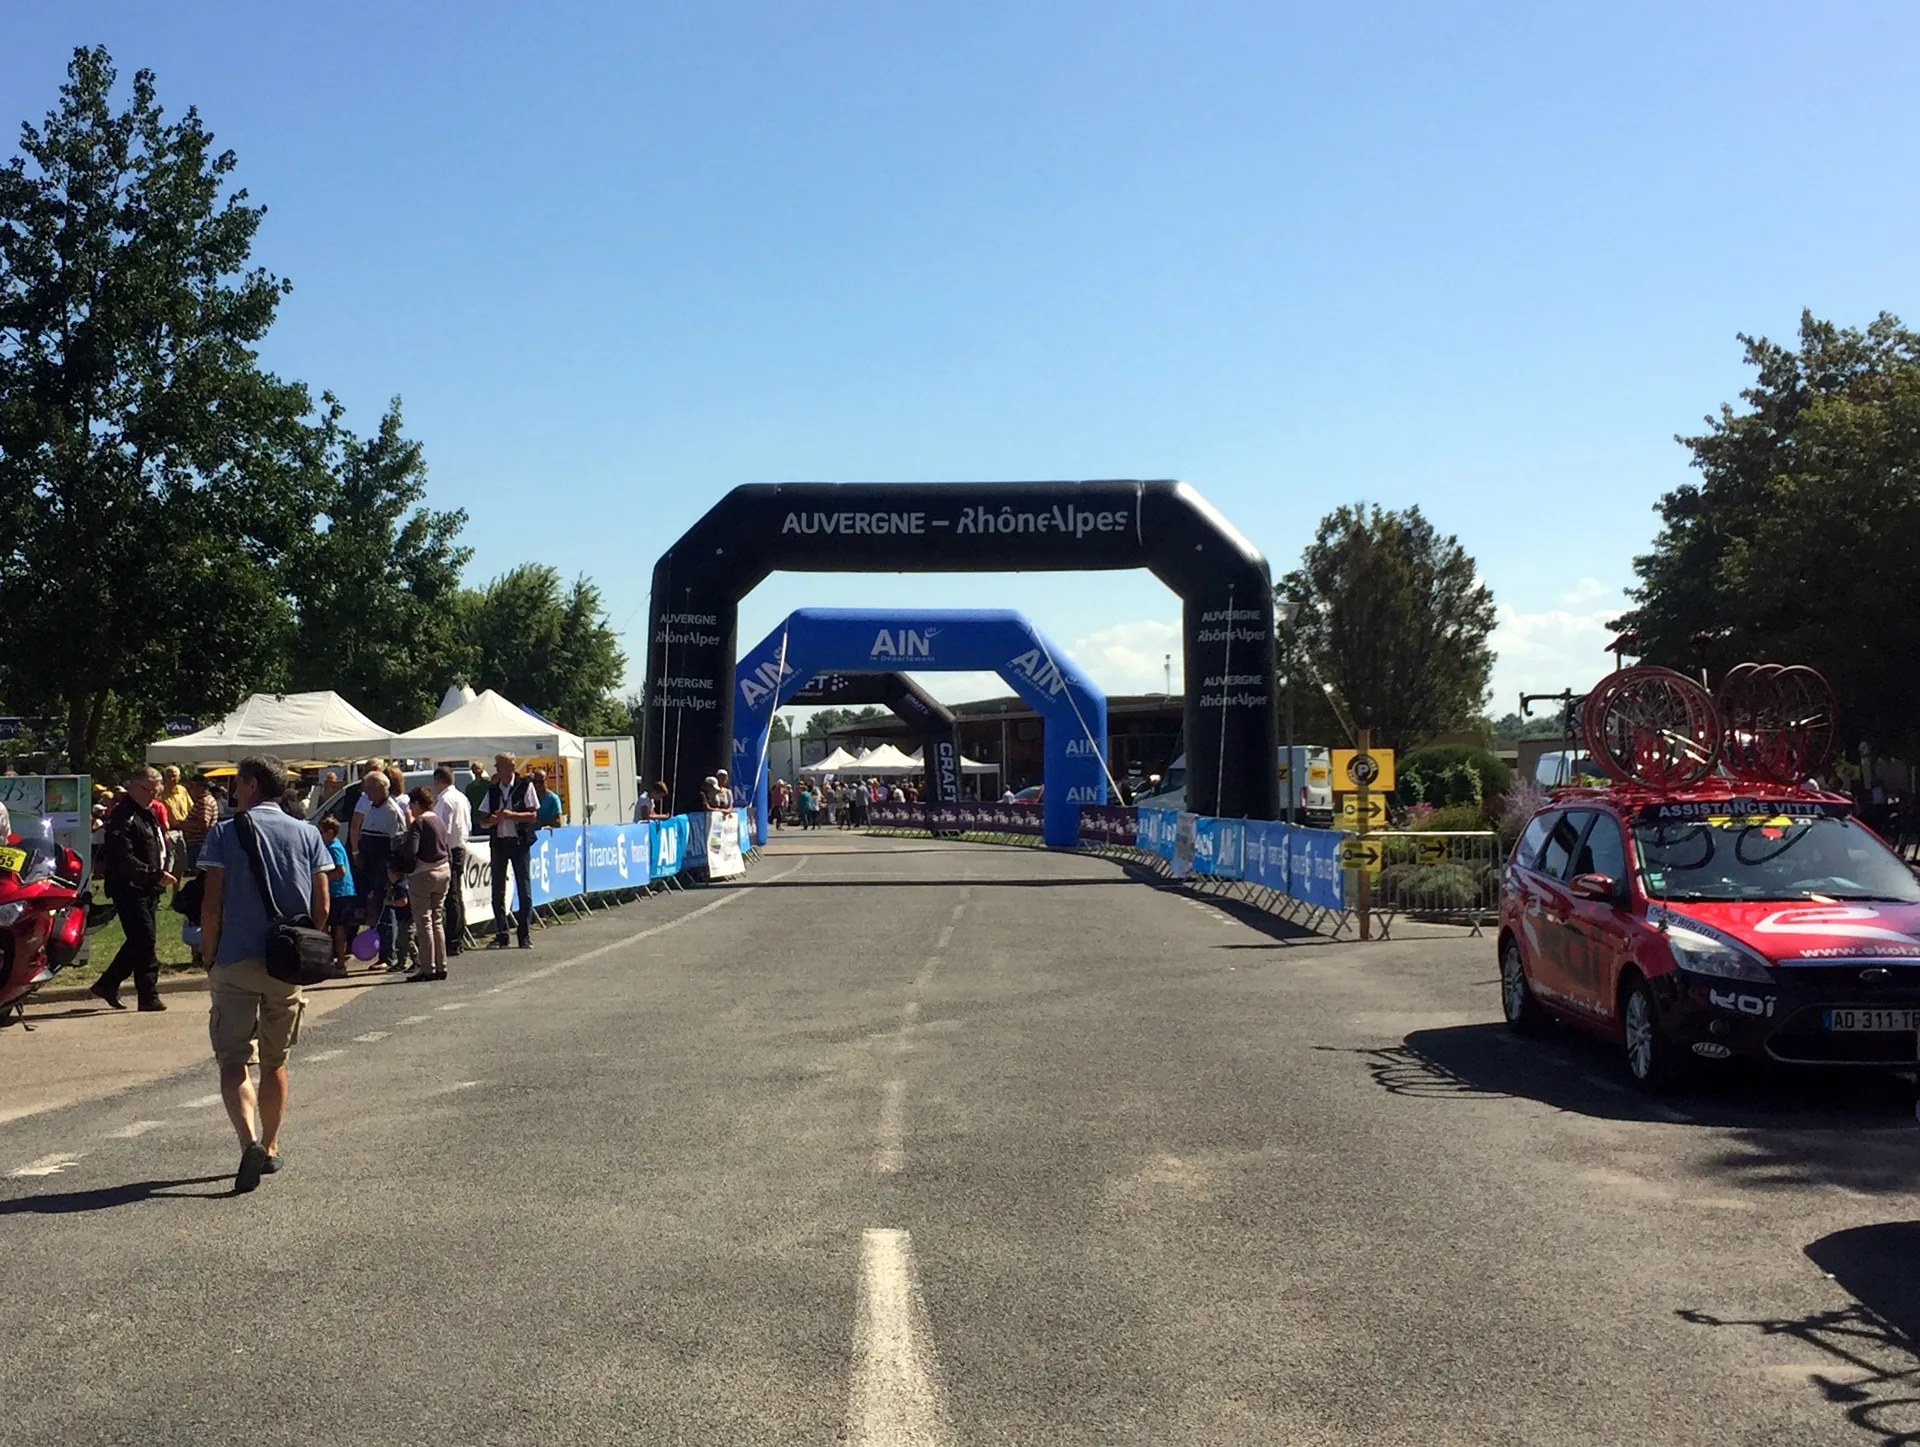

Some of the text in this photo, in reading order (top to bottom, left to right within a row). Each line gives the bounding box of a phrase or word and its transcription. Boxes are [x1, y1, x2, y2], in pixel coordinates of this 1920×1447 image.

[782, 512, 926, 535] AUVERGNE
[660, 614, 717, 625] AUVERGNE
[1201, 610, 1261, 622] AUVERGNE
[870, 628, 930, 656] AIN
[1011, 648, 1064, 696] AIN
[657, 678, 714, 689] AUVERGNE
[740, 661, 793, 707] AIN
[1203, 675, 1263, 687] AUVERGNE
[1065, 739, 1098, 754] AIN
[939, 742, 957, 804] CRAFT
[1066, 786, 1098, 801] AIN
[1658, 802, 1826, 818] ASSISTANCE VITTA
[590, 843, 617, 867] france
